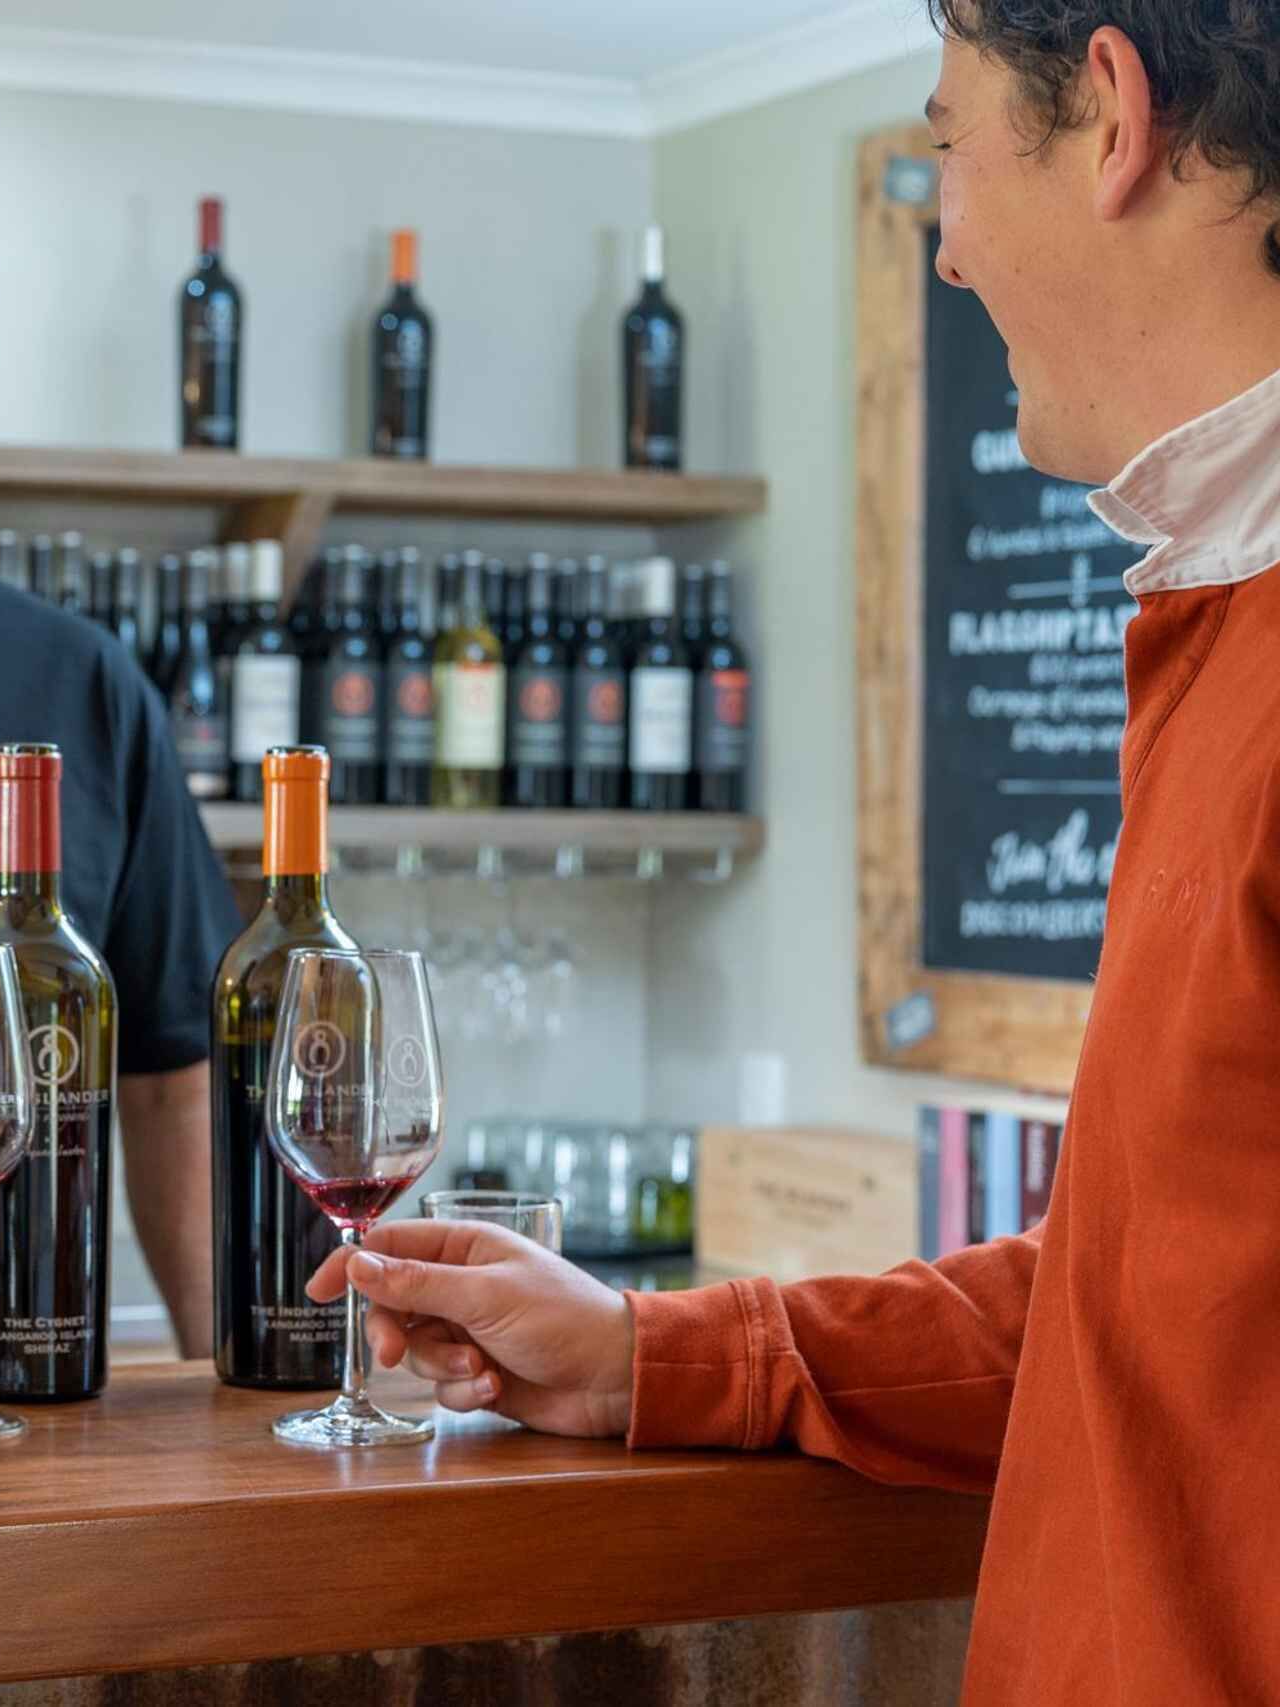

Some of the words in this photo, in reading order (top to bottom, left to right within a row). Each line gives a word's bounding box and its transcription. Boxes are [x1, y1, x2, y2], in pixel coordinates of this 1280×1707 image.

[279, 1304, 350, 1317] INDEPEND
[3, 1317, 32, 1328] THE
[23, 1344, 70, 1355] SHIRAZ
